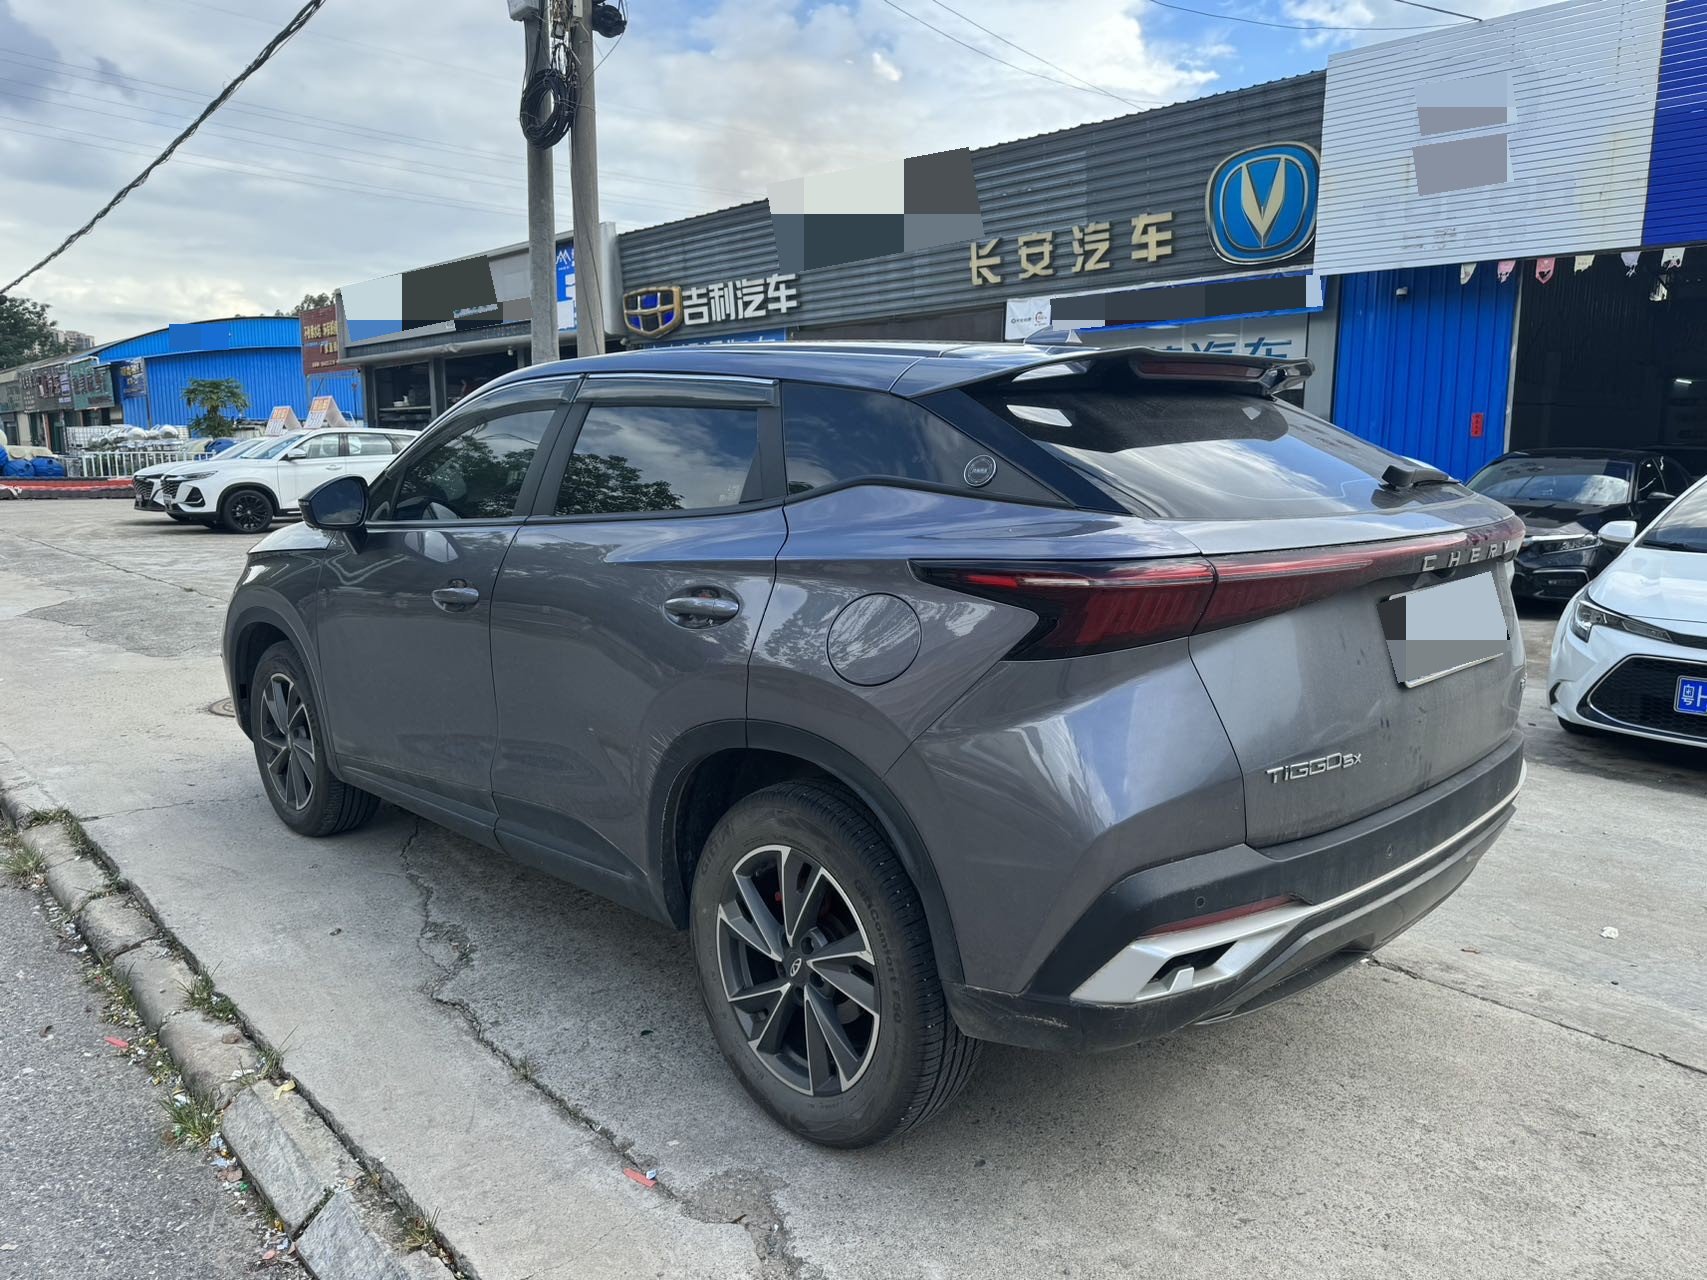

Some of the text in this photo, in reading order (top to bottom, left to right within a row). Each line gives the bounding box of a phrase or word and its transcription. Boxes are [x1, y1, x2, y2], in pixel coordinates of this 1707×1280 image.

[969, 212, 1172, 286] 长安汽车
[682, 273, 797, 325] 吉利汽车
[1422, 540, 1511, 572] CHERY
